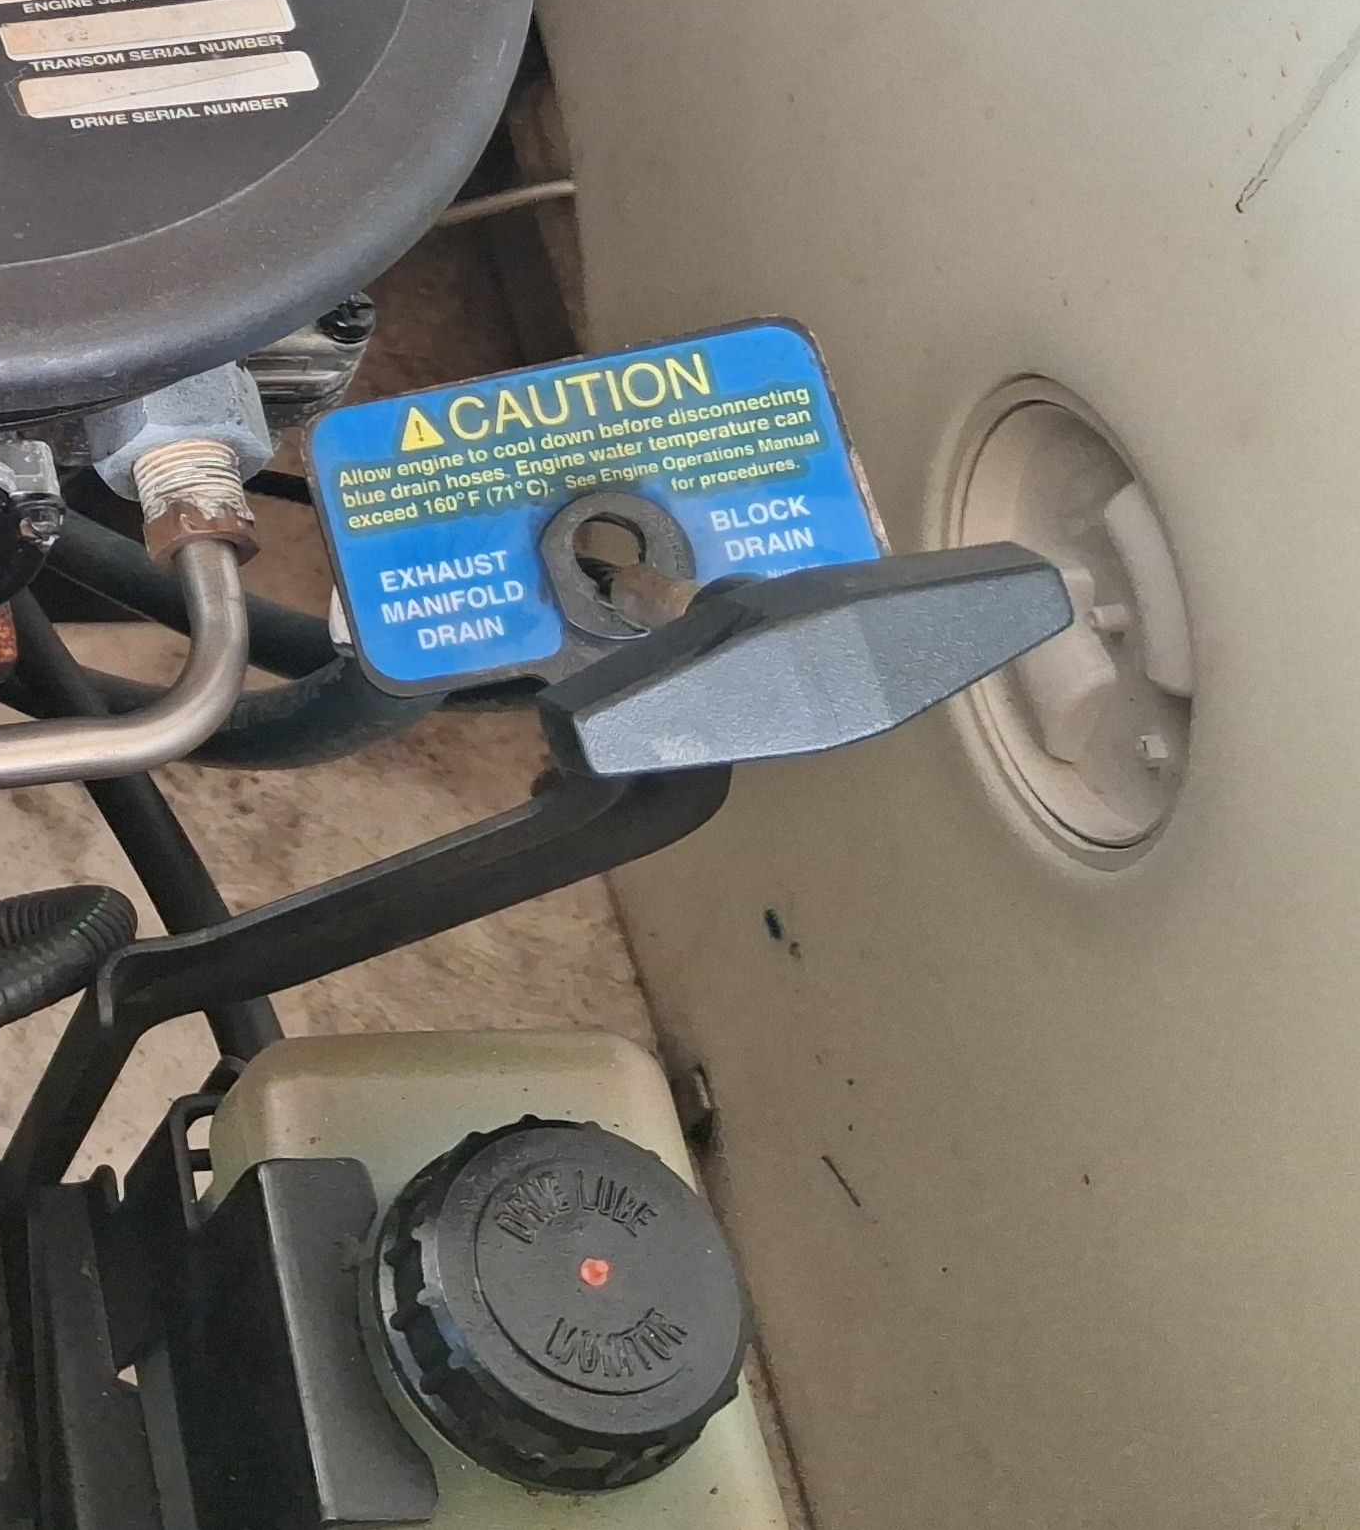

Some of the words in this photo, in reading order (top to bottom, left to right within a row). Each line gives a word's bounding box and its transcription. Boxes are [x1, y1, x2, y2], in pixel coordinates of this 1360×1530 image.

[29, 53, 125, 72] TRANSOM
[129, 44, 195, 62] SERIAL
[199, 35, 284, 56] NUMBER
[70, 111, 129, 130] DRIVE
[131, 107, 200, 125] SERIAL
[203, 97, 289, 118] NUMBER
[448, 353, 712, 441] CAUTION
[339, 467, 392, 487] Allow
[397, 452, 464, 476] engine
[467, 448, 488, 463] to
[493, 437, 536, 458] cool
[540, 428, 595, 451] down
[599, 415, 663, 440] before
[668, 387, 810, 427] disconnecting
[342, 488, 386, 509] blue
[390, 479, 441, 501] drain
[446, 467, 511, 490] hoses.
[516, 449, 585, 477] Engine
[589, 439, 643, 463] water
[648, 419, 770, 449] temperature
[775, 408, 812, 429] can
[348, 503, 419, 529] exceed
[565, 472, 597, 490] See
[599, 460, 659, 484] Engine
[662, 441, 755, 471] Operations
[758, 429, 821, 453] Manual
[671, 475, 695, 492] for
[699, 458, 801, 489] procedures.
[710, 495, 811, 533] BLOCK
[724, 527, 815, 562] DRAIN
[380, 549, 508, 593] EXHAUST
[381, 580, 524, 624] MANIFOLD
[417, 615, 505, 651] DRAIN
[576, 1169, 659, 1238] LUBE
